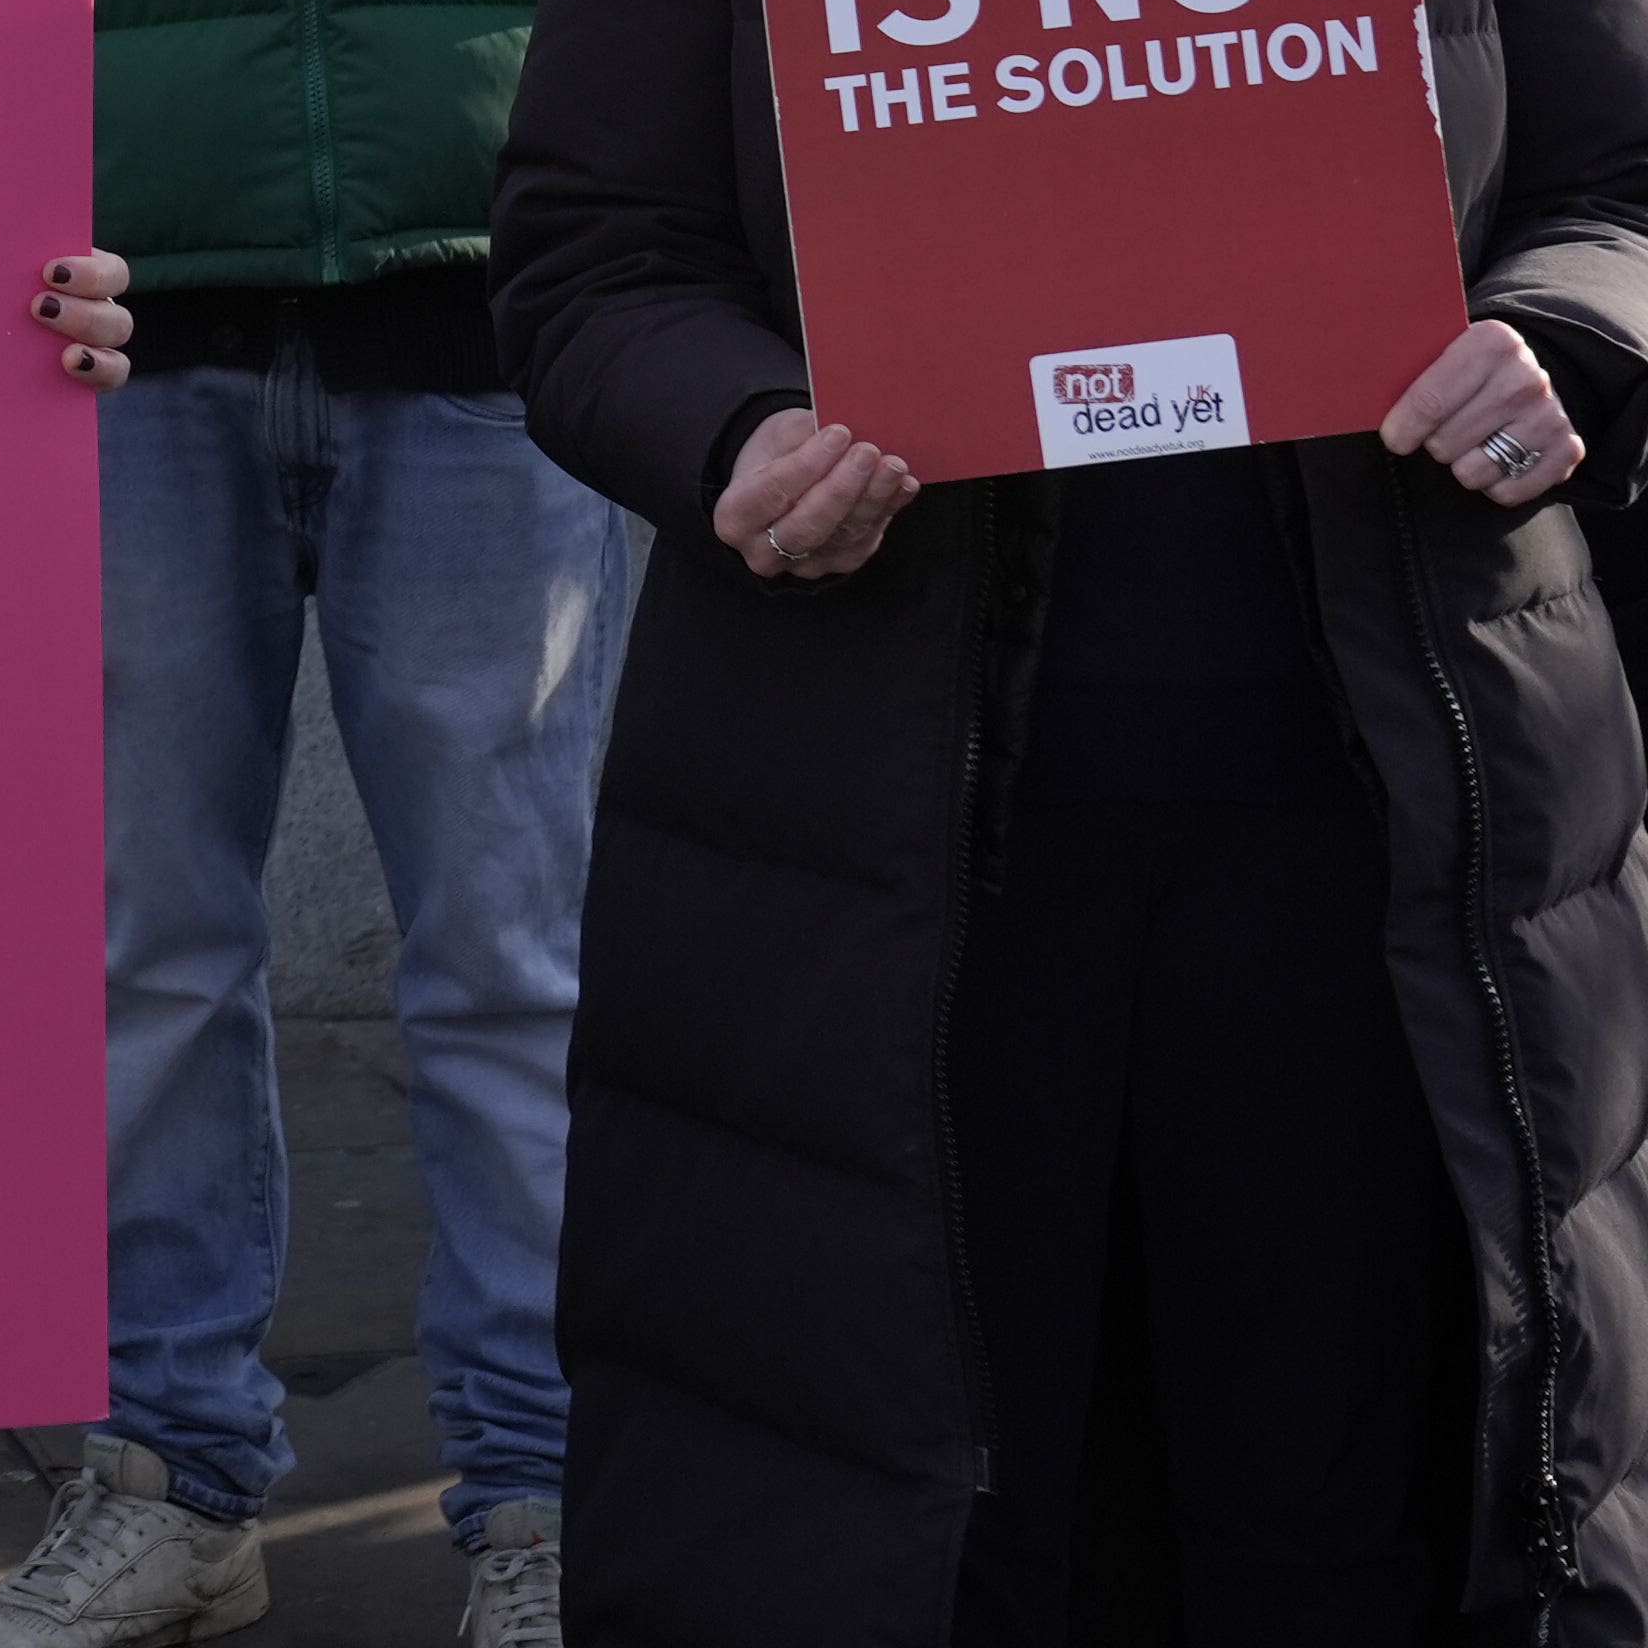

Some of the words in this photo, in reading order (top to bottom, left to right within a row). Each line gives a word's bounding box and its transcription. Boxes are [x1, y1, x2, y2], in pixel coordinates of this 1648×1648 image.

[825, 63, 976, 131] THE
[996, 17, 1377, 112] SOLUTION
[1065, 365, 1125, 400] not
[1187, 384, 1214, 402] UK
[1073, 393, 1161, 435] dead
[1171, 392, 1225, 433] yet
